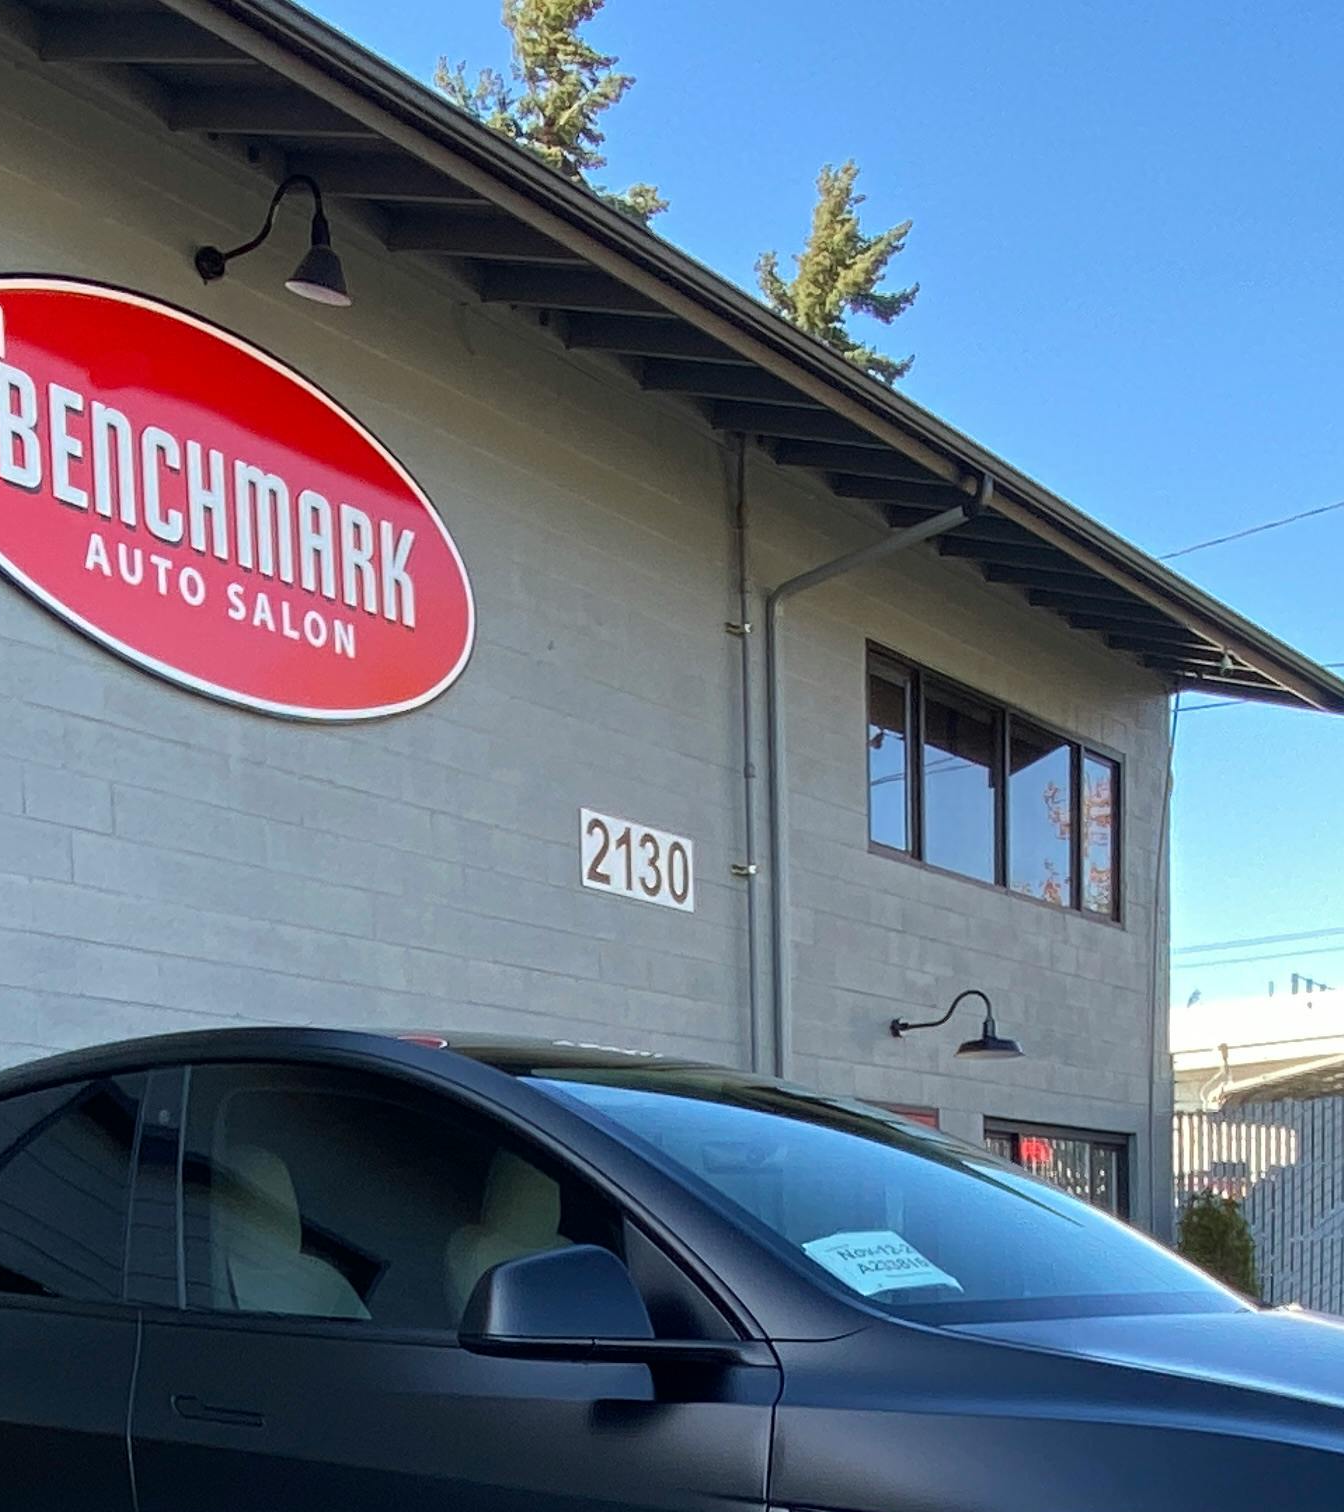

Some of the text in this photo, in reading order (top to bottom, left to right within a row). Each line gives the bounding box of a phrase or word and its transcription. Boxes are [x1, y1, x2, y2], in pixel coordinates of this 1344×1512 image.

[85, 532, 356, 658] AUTO SALON
[586, 818, 690, 904] 2130
